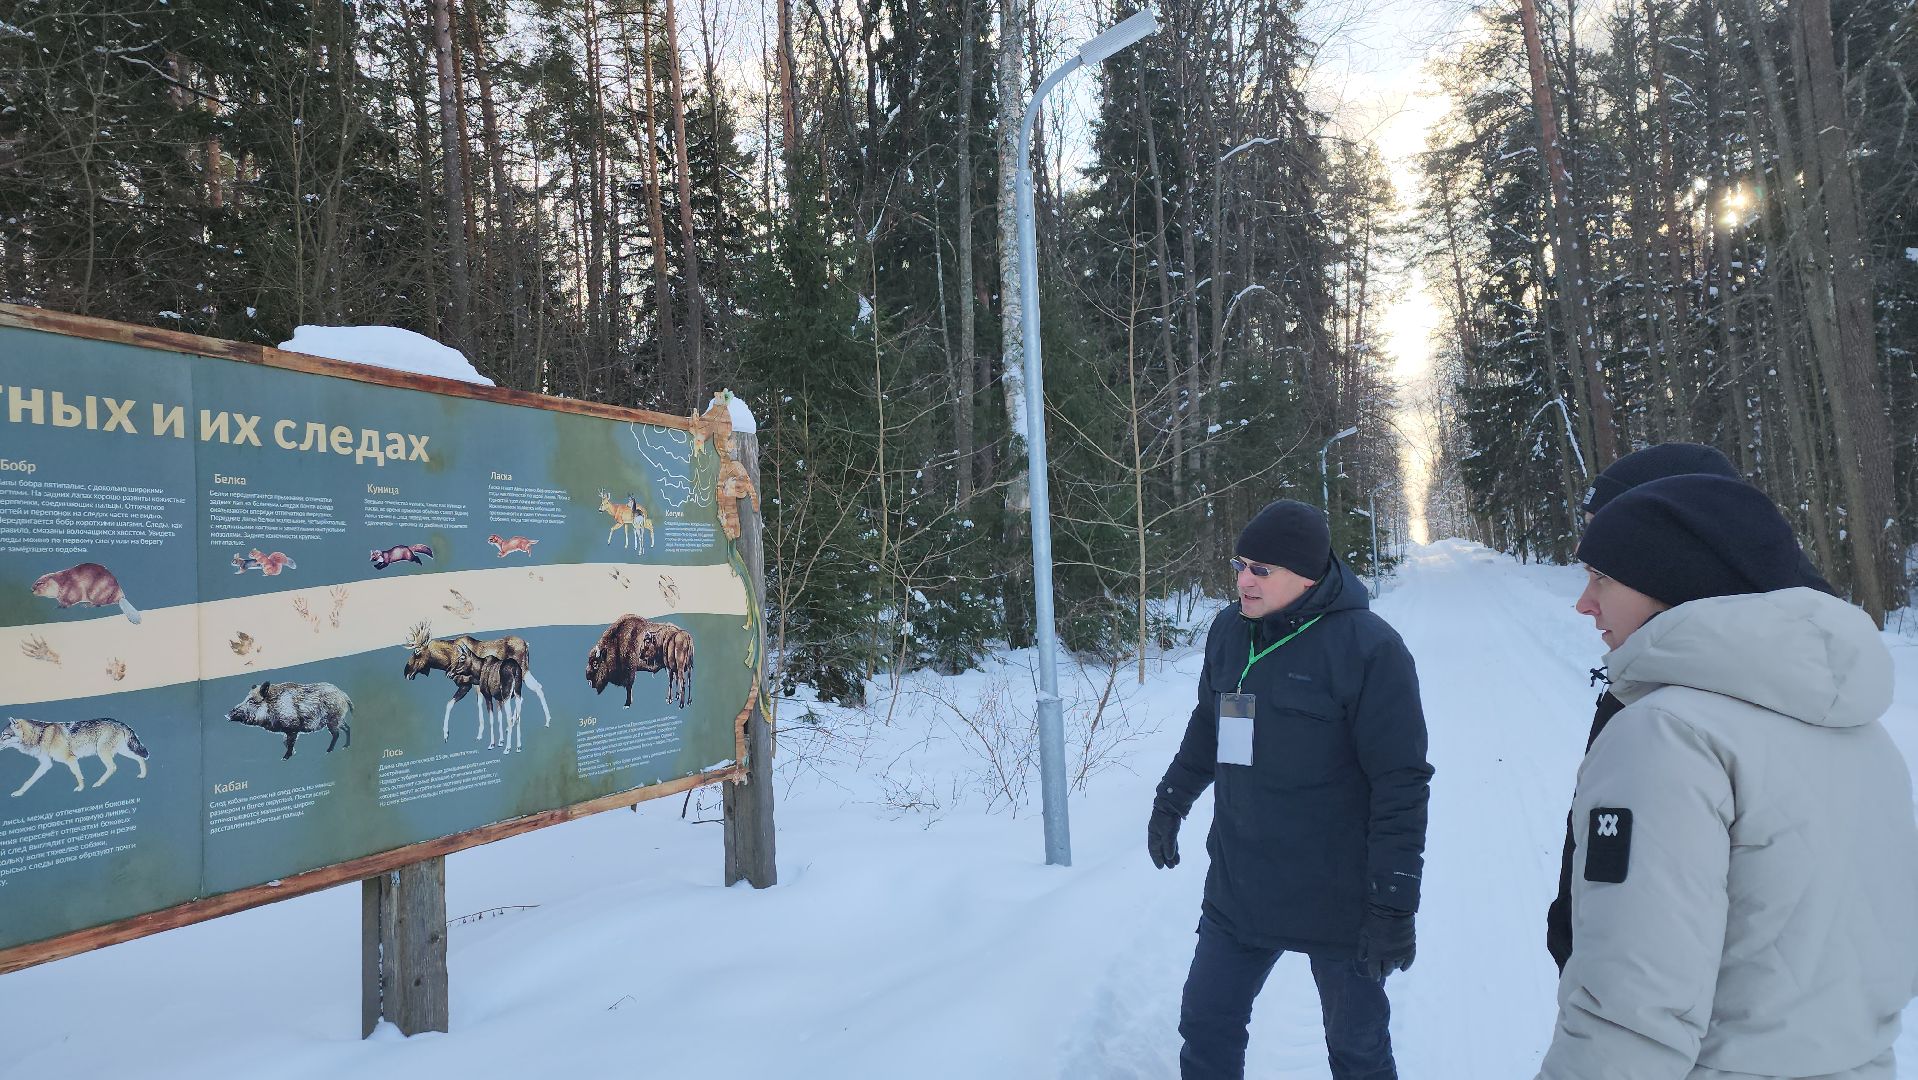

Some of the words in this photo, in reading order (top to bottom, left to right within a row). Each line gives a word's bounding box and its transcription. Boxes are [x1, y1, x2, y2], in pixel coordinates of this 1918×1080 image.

[0, 385, 138, 434] ных
[152, 402, 185, 439] и
[200, 409, 263, 447] их
[273, 418, 430, 466] следах
[0, 459, 37, 475] Бобр
[213, 473, 247, 486] Белка
[490, 471, 512, 481] Ласка
[18, 479, 42, 488] бобра
[127, 486, 164, 494] широкими
[367, 483, 400, 496] Куница
[43, 491, 69, 499] задних
[93, 493, 120, 501] хорошо
[122, 494, 150, 502] развиты
[124, 502, 164, 510] Отпечатков
[30, 509, 71, 517] перепонок
[0, 518, 53, 526] ередвигается
[55, 518, 74, 527] бобр
[75, 520, 115, 528] короткими
[66, 529, 115, 537] волочащимся
[147, 528, 175, 538] Увидеть
[94, 538, 114, 546] снегу
[139, 537, 163, 546] берегу
[578, 716, 598, 728] Зубр
[382, 748, 404, 759] Лось
[213, 780, 249, 796] Кабан
[294, 793, 312, 801] Почти
[26, 813, 53, 821] между
[55, 804, 103, 817] отпечатками
[104, 799, 135, 808] боковых
[8, 825, 35, 834] можно
[37, 819, 73, 830] провести
[74, 814, 103, 823] прямую
[18, 830, 58, 842] пересечёт
[60, 824, 98, 835] отпечатки
[100, 818, 130, 828] боковых
[7, 846, 27, 854] след
[28, 839, 65, 850] выглядит
[0, 857, 24, 866] ольку
[46, 846, 78, 857] тяжелее
[28, 860, 53, 869] следы
[55, 855, 77, 864] волка
[78, 848, 113, 859] образуют
[114, 844, 136, 852] почти
